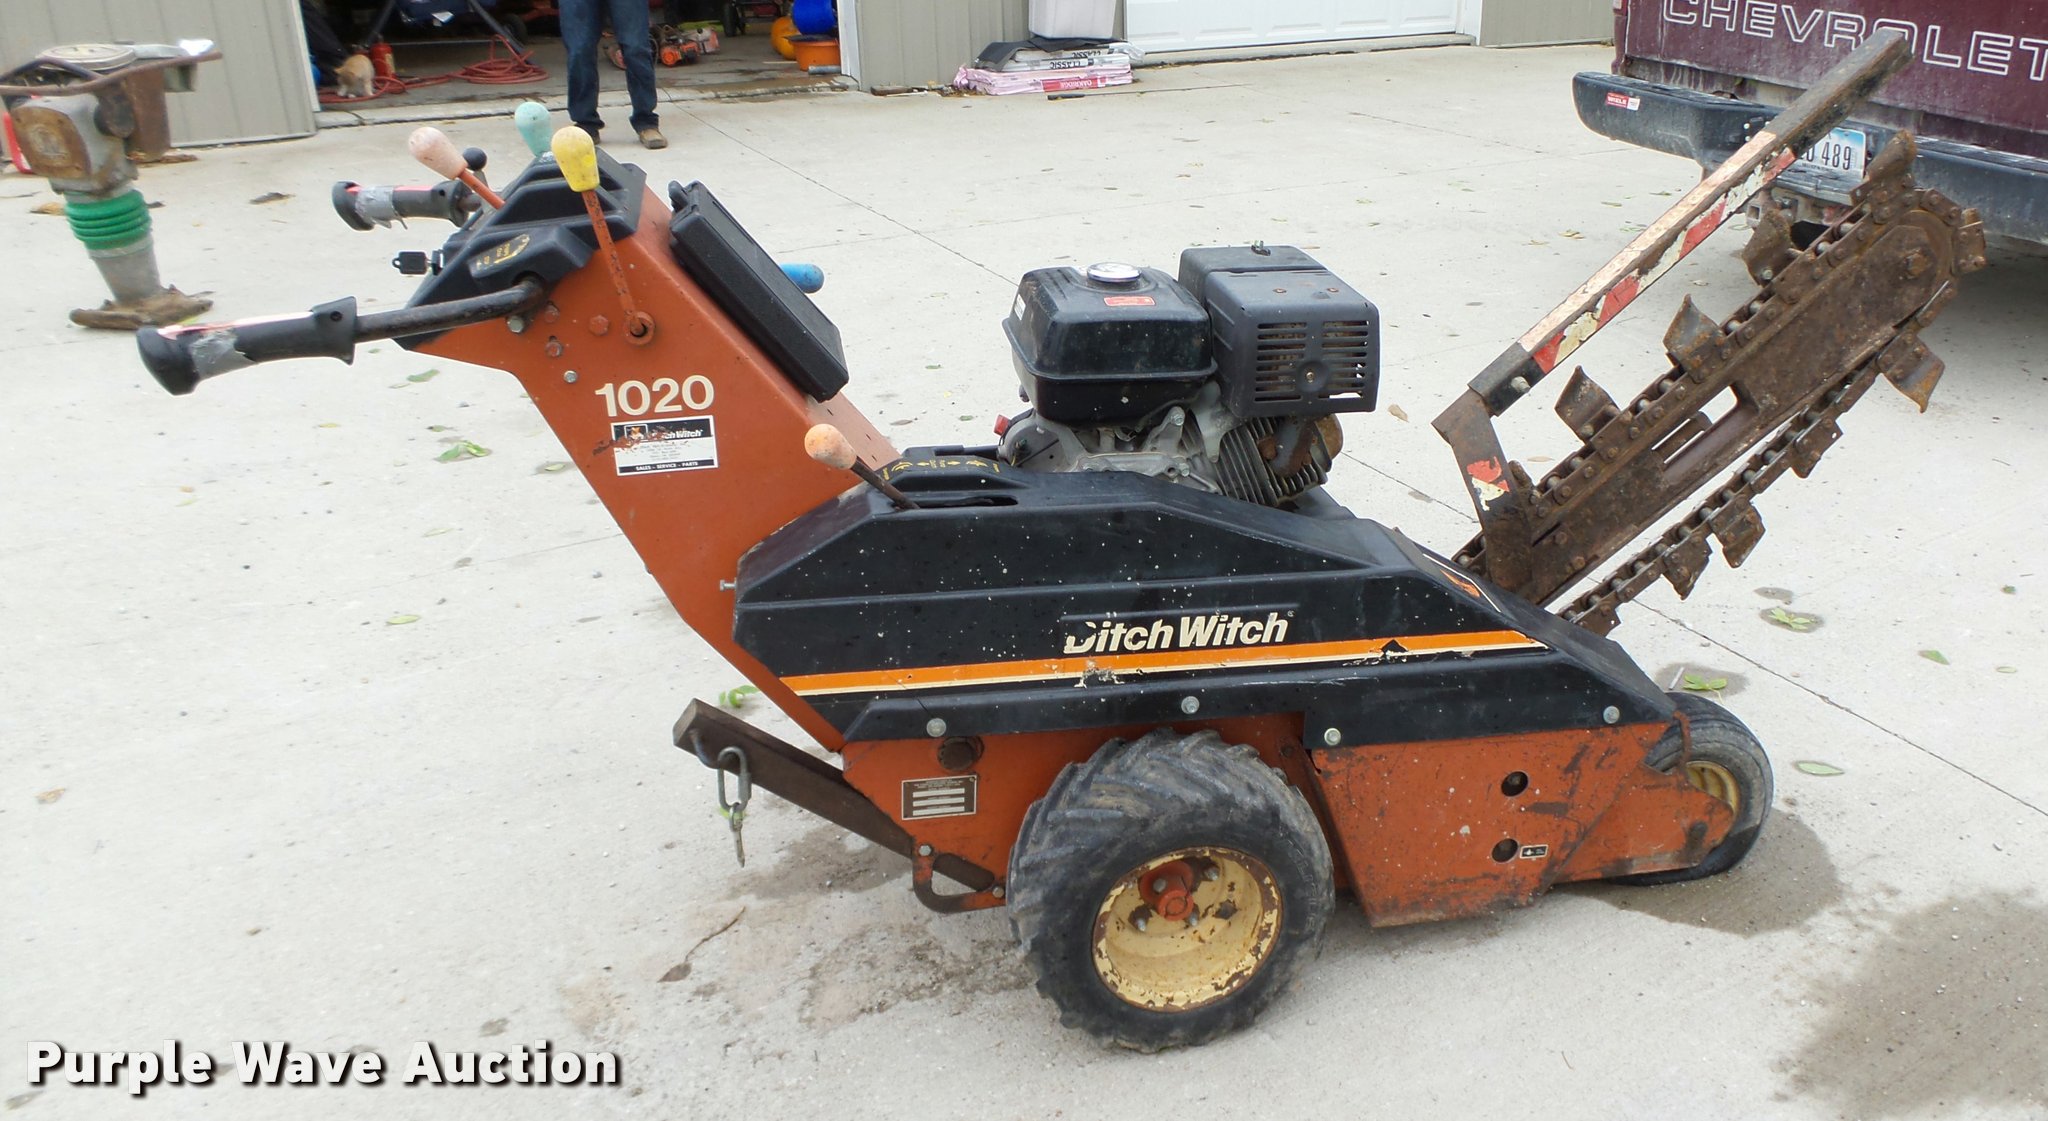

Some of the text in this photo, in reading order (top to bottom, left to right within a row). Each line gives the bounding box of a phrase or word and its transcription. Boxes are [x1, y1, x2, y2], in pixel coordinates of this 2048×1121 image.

[1663, 0, 2048, 81] CHEVROLET
[1049, 61, 1081, 69] CLASSIC
[1821, 141, 1852, 171] 489
[594, 374, 715, 417] 1020
[1178, 612, 1289, 648] Witch
